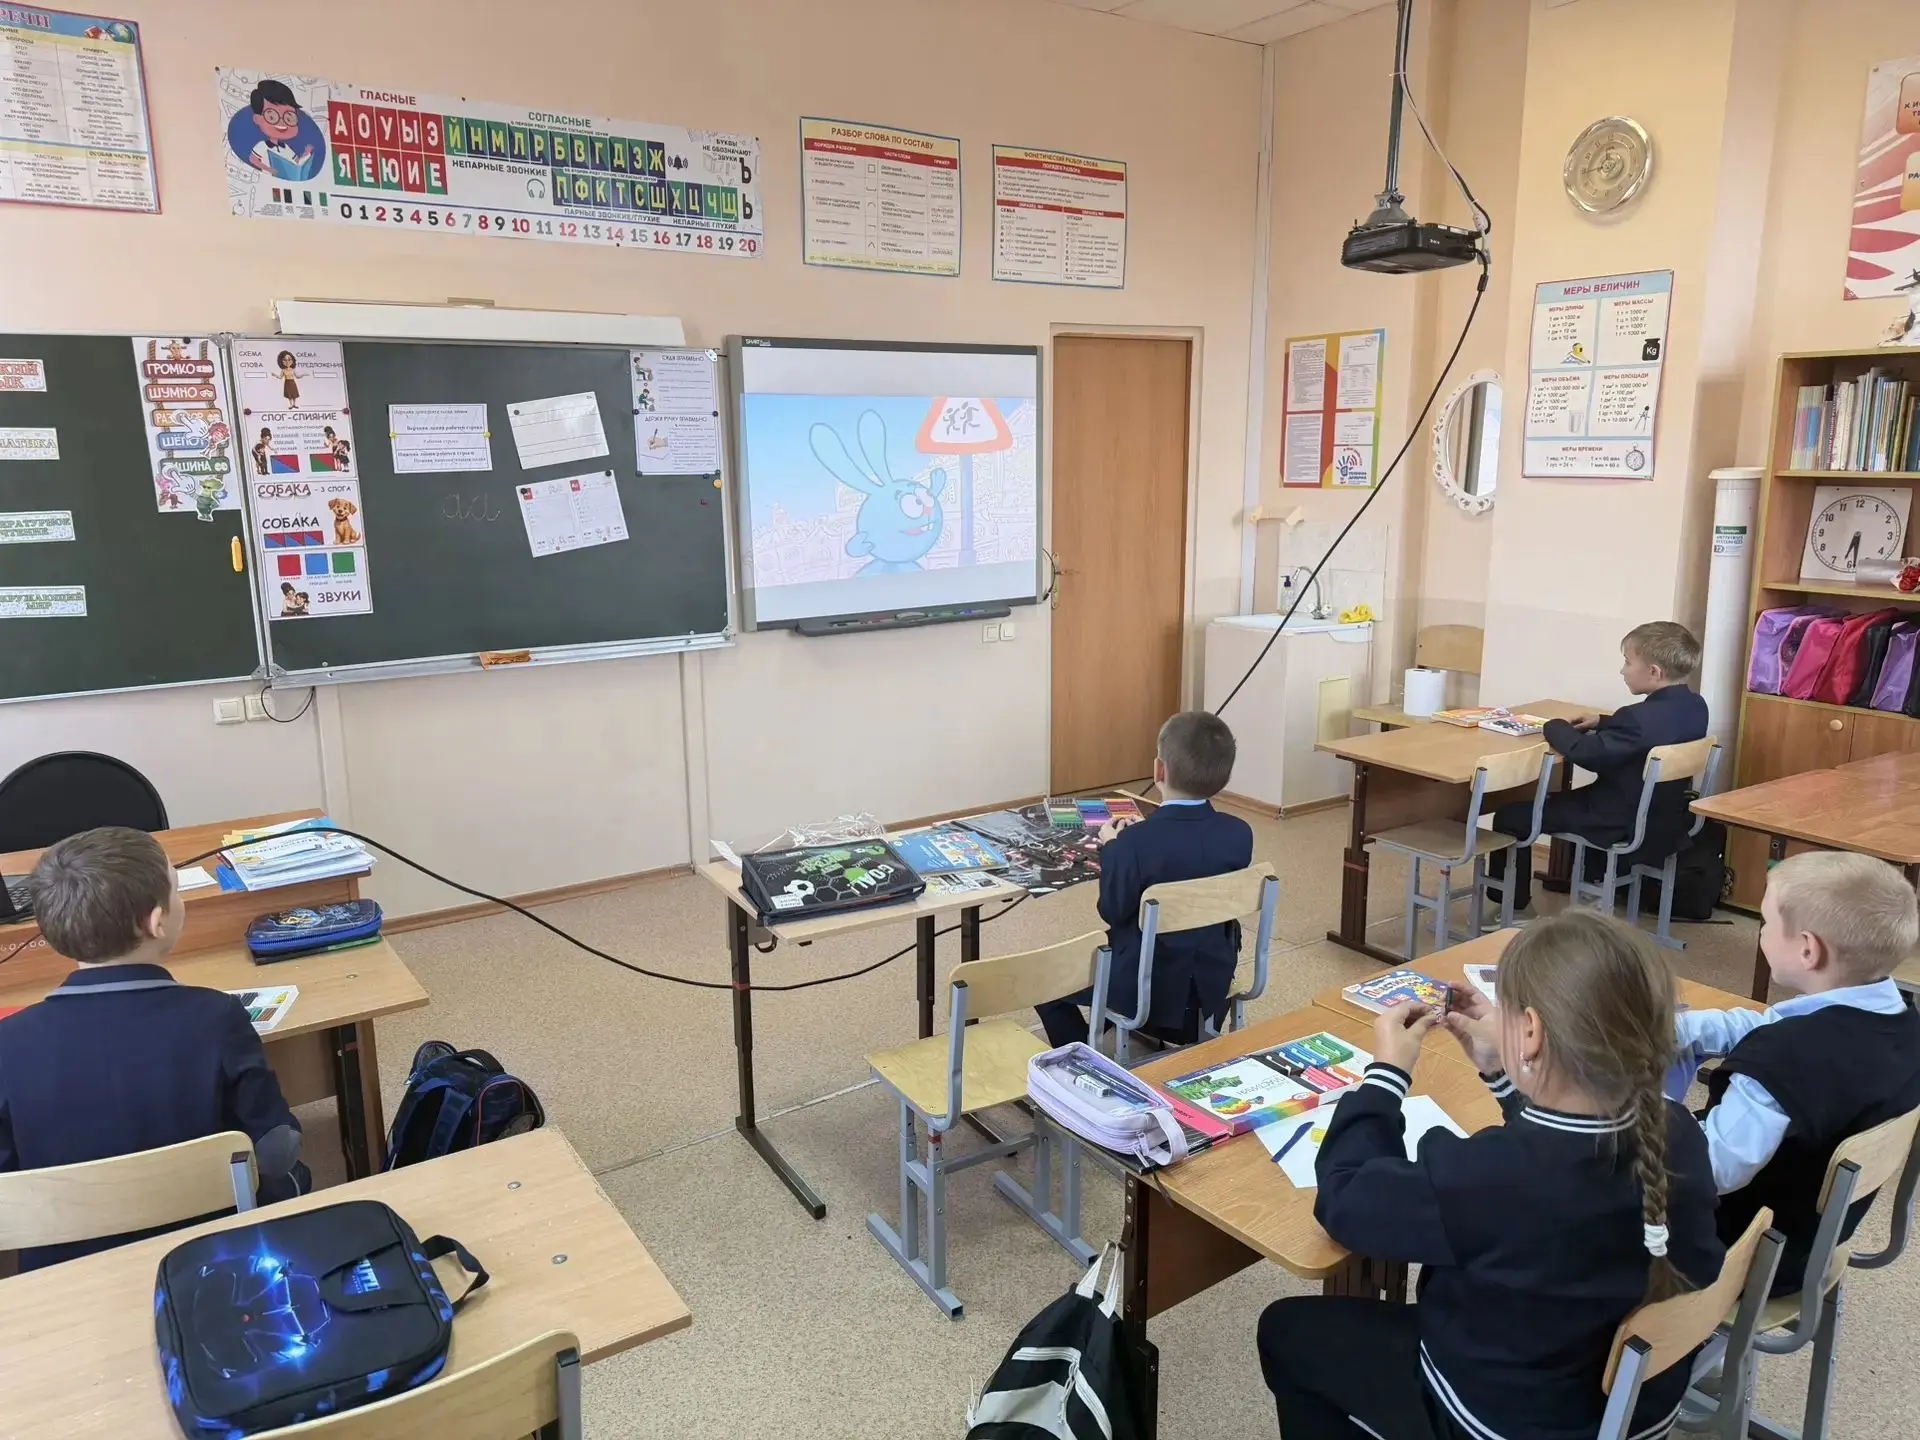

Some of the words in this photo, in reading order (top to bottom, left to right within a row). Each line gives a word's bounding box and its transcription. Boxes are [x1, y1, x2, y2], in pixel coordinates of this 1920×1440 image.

[360, 89, 417, 106] ГЛАСНЫЕ
[528, 111, 592, 128] СОГЛАСНЫЕ
[335, 110, 348, 136] А
[358, 113, 370, 139] О
[380, 115, 392, 141] У
[401, 118, 419, 144] Ы
[426, 120, 438, 146] Э
[448, 117, 461, 149] Й
[470, 126, 483, 151] Н
[491, 129, 504, 153] М
[513, 132, 525, 156] Л
[533, 134, 544, 158] Р
[554, 137, 565, 160] Б
[575, 139, 585, 162] В
[594, 142, 603, 164] Г
[613, 143, 624, 168] Д
[633, 146, 642, 169] З
[648, 148, 664, 172] Ж
[716, 139, 738, 147] БУКВЫ
[831, 127, 866, 139] РАЗБОР
[864, 131, 890, 143] СЛОВА
[891, 135, 901, 144] ПО
[903, 137, 935, 150] СОСТАВУ
[712, 146, 751, 156] ОБОЗНАЧАЮТ
[813, 141, 835, 149] ПОРЯДОК
[835, 144, 857, 152] РАЗБОРА
[718, 154, 738, 162] ЗВУКИ
[884, 151, 897, 159] ЧАСТИ
[1024, 151, 1065, 162] ФОНЕТИЧЕСКИЙ
[1065, 157, 1082, 165] РАЗБОР
[338, 153, 351, 178] Я
[361, 153, 374, 183] Ё
[381, 157, 399, 184] Ю
[407, 160, 420, 185] И
[429, 162, 442, 187] Е
[452, 160, 505, 172] НЕПАРНЫЕ
[506, 165, 547, 176] ЗВОНКИЕ
[739, 157, 752, 184] Ъ
[556, 176, 567, 199] П
[575, 178, 589, 201] Ф
[596, 180, 607, 203] К
[616, 182, 625, 205] Т
[635, 184, 644, 207] С
[650, 186, 666, 208] Ш
[672, 188, 681, 210] Х
[689, 188, 700, 214] Ц
[707, 192, 717, 214] Ч
[722, 192, 737, 217] Щ
[742, 193, 753, 220] Ь
[564, 208, 596, 218] ПАРНЫЕ
[598, 211, 660, 223] ЗВОНКИЕ/ГЛУХИЕ
[340, 203, 353, 219] 0
[359, 205, 369, 220] 1
[375, 206, 387, 222] 2
[392, 208, 404, 223] 3
[410, 209, 422, 225] 4
[428, 211, 439, 226] 5
[445, 212, 456, 227] 6
[462, 213, 472, 229] 7
[478, 215, 489, 230] 8
[495, 216, 505, 231] 9
[512, 217, 530, 233] 10
[536, 220, 553, 235] 11
[559, 222, 577, 237] 12
[583, 224, 601, 239] 13
[606, 226, 624, 241] 14
[631, 228, 648, 243] 15
[653, 230, 671, 245] 16
[676, 232, 692, 247] 17
[696, 234, 713, 249] 18
[718, 236, 734, 250] 19
[739, 239, 757, 253] 20
[672, 218, 711, 228] НЕПАРНЫЕ
[712, 221, 737, 230] ГЛУХИЕ
[1563, 286, 1591, 296] МЕРЫ
[1593, 280, 1640, 293] ВЕЛИЧИН
[1646, 346, 1657, 356] Kg
[146, 363, 196, 376] ГРОМКО
[148, 386, 198, 399] ШУМНО
[257, 483, 311, 495] СОБАКА
[1840, 503, 1847, 512] 11
[1855, 500, 1866, 508] 12
[1874, 504, 1879, 513] 1
[262, 517, 320, 529] СОБАКА
[1825, 513, 1834, 522] 10
[1885, 515, 1892, 524] 2
[1818, 528, 1825, 537] 9
[1886, 531, 1894, 541] 3
[1820, 543, 1826, 552] 8
[1878, 546, 1884, 555] 4
[1831, 556, 1837, 564] 7
[1846, 560, 1852, 569] 6
[317, 590, 361, 603] ЗВУКИ
